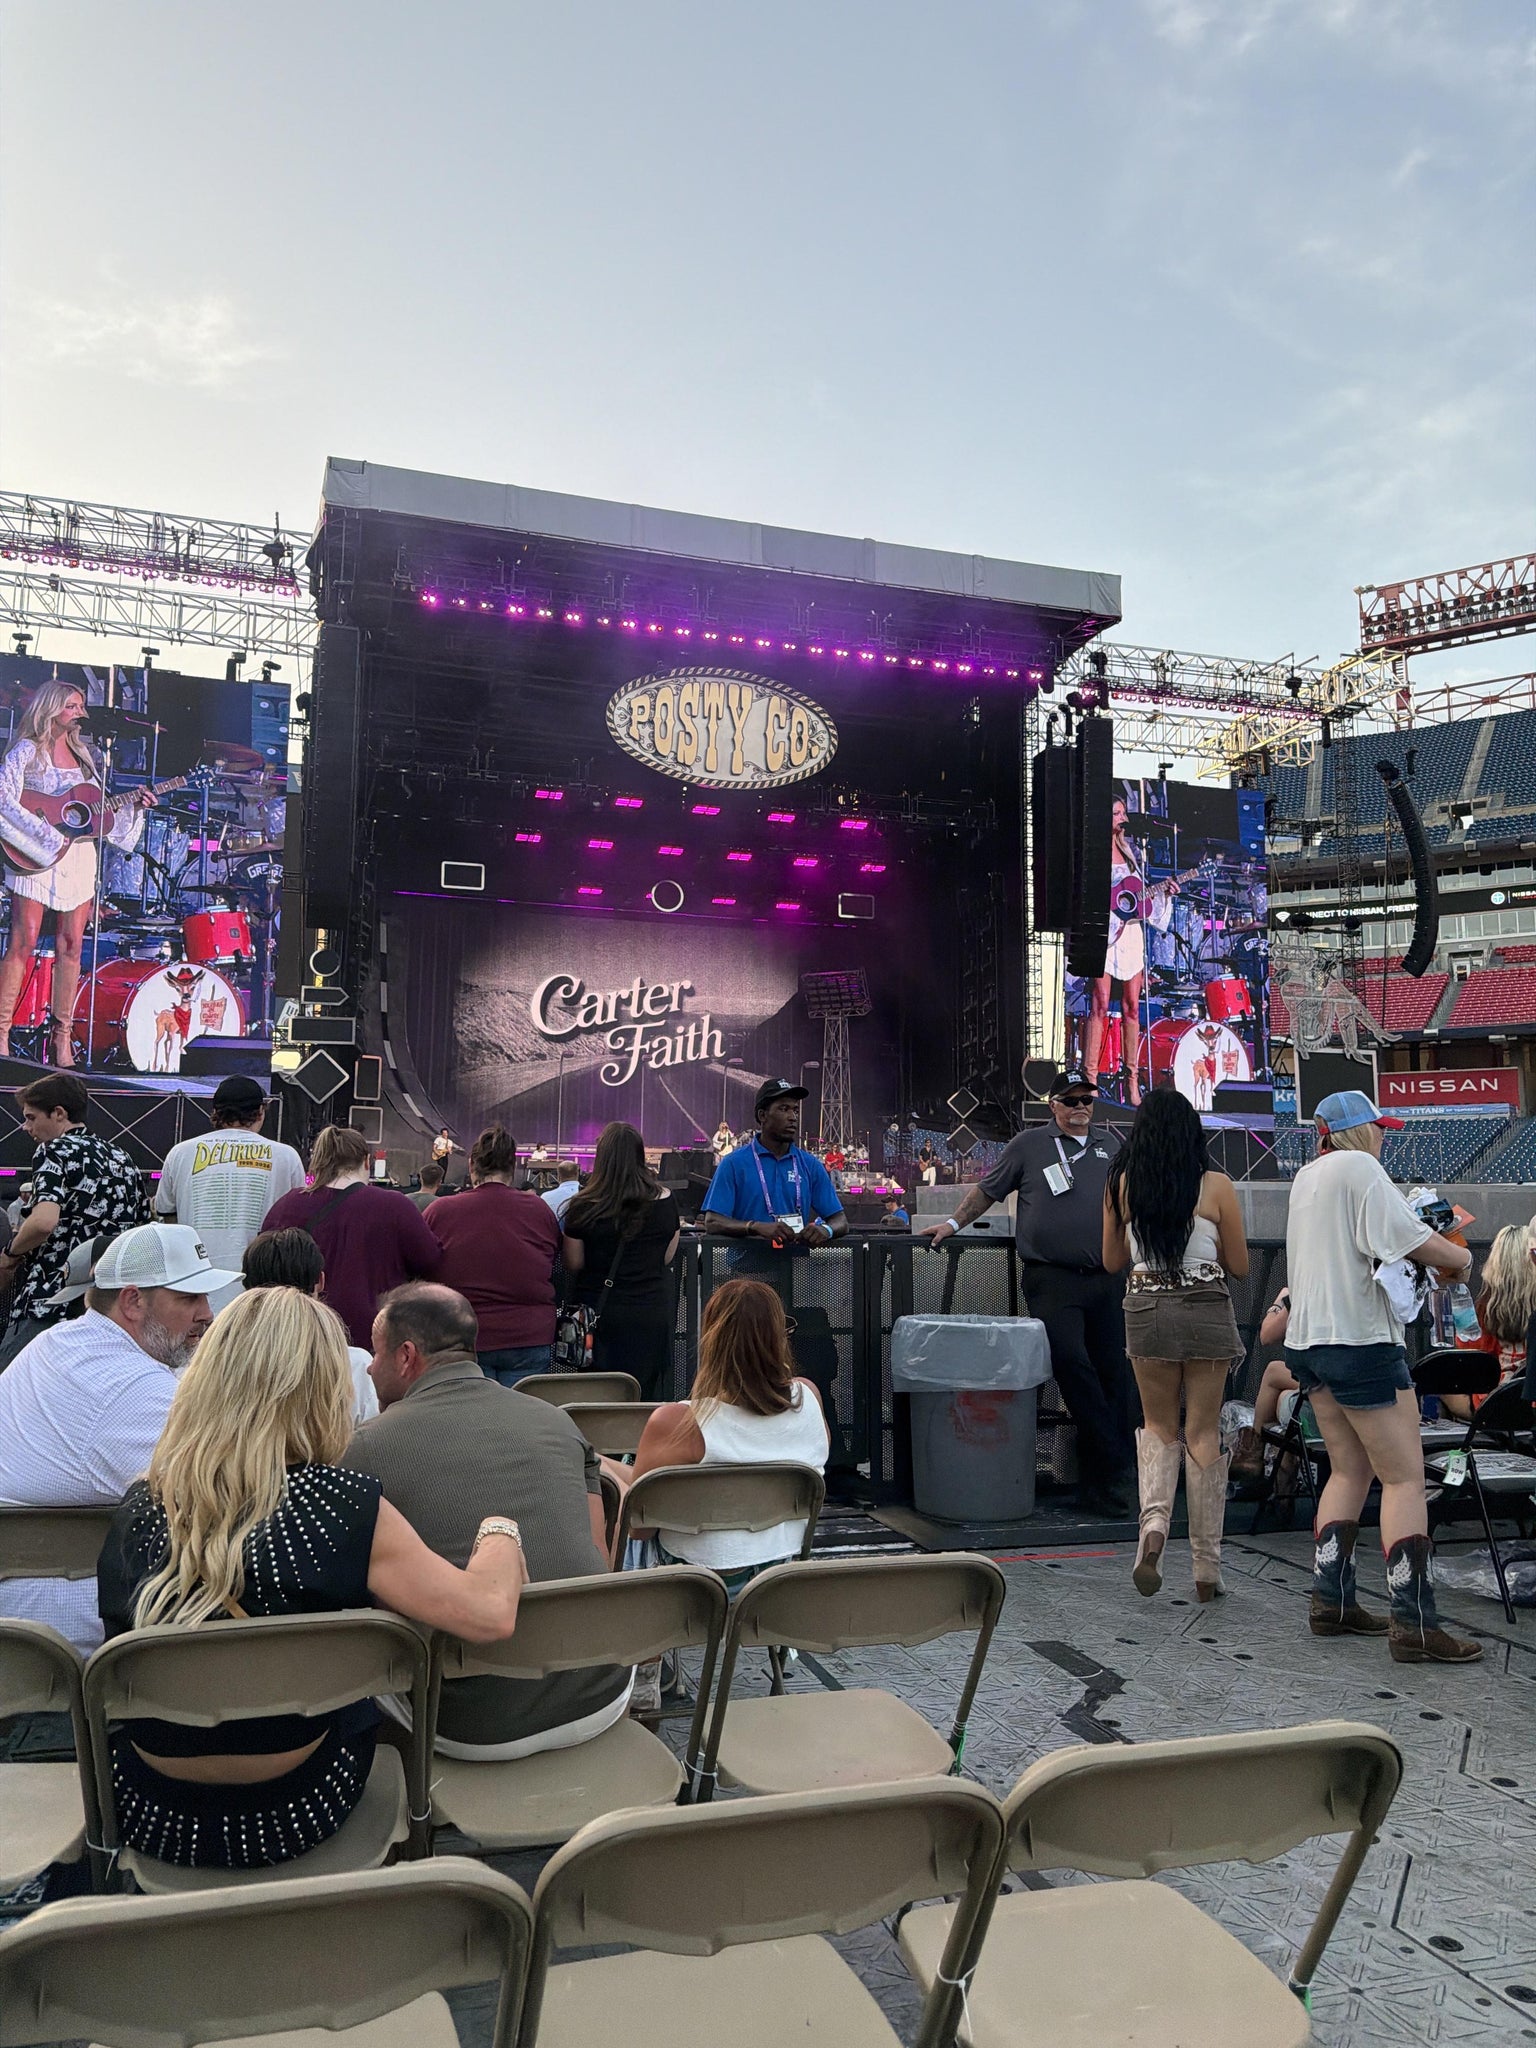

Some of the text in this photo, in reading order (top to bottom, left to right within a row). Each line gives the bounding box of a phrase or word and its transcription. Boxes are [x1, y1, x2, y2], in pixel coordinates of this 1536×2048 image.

[627, 682, 820, 775] POSTY CO.
[1336, 909, 1349, 917] TO
[531, 974, 692, 1036] Carter
[600, 1014, 726, 1087] Faith
[1389, 1078, 1499, 1095] NISSAN
[1410, 1107, 1445, 1115] TITANS
[192, 1142, 272, 1175] DELIRIUM
